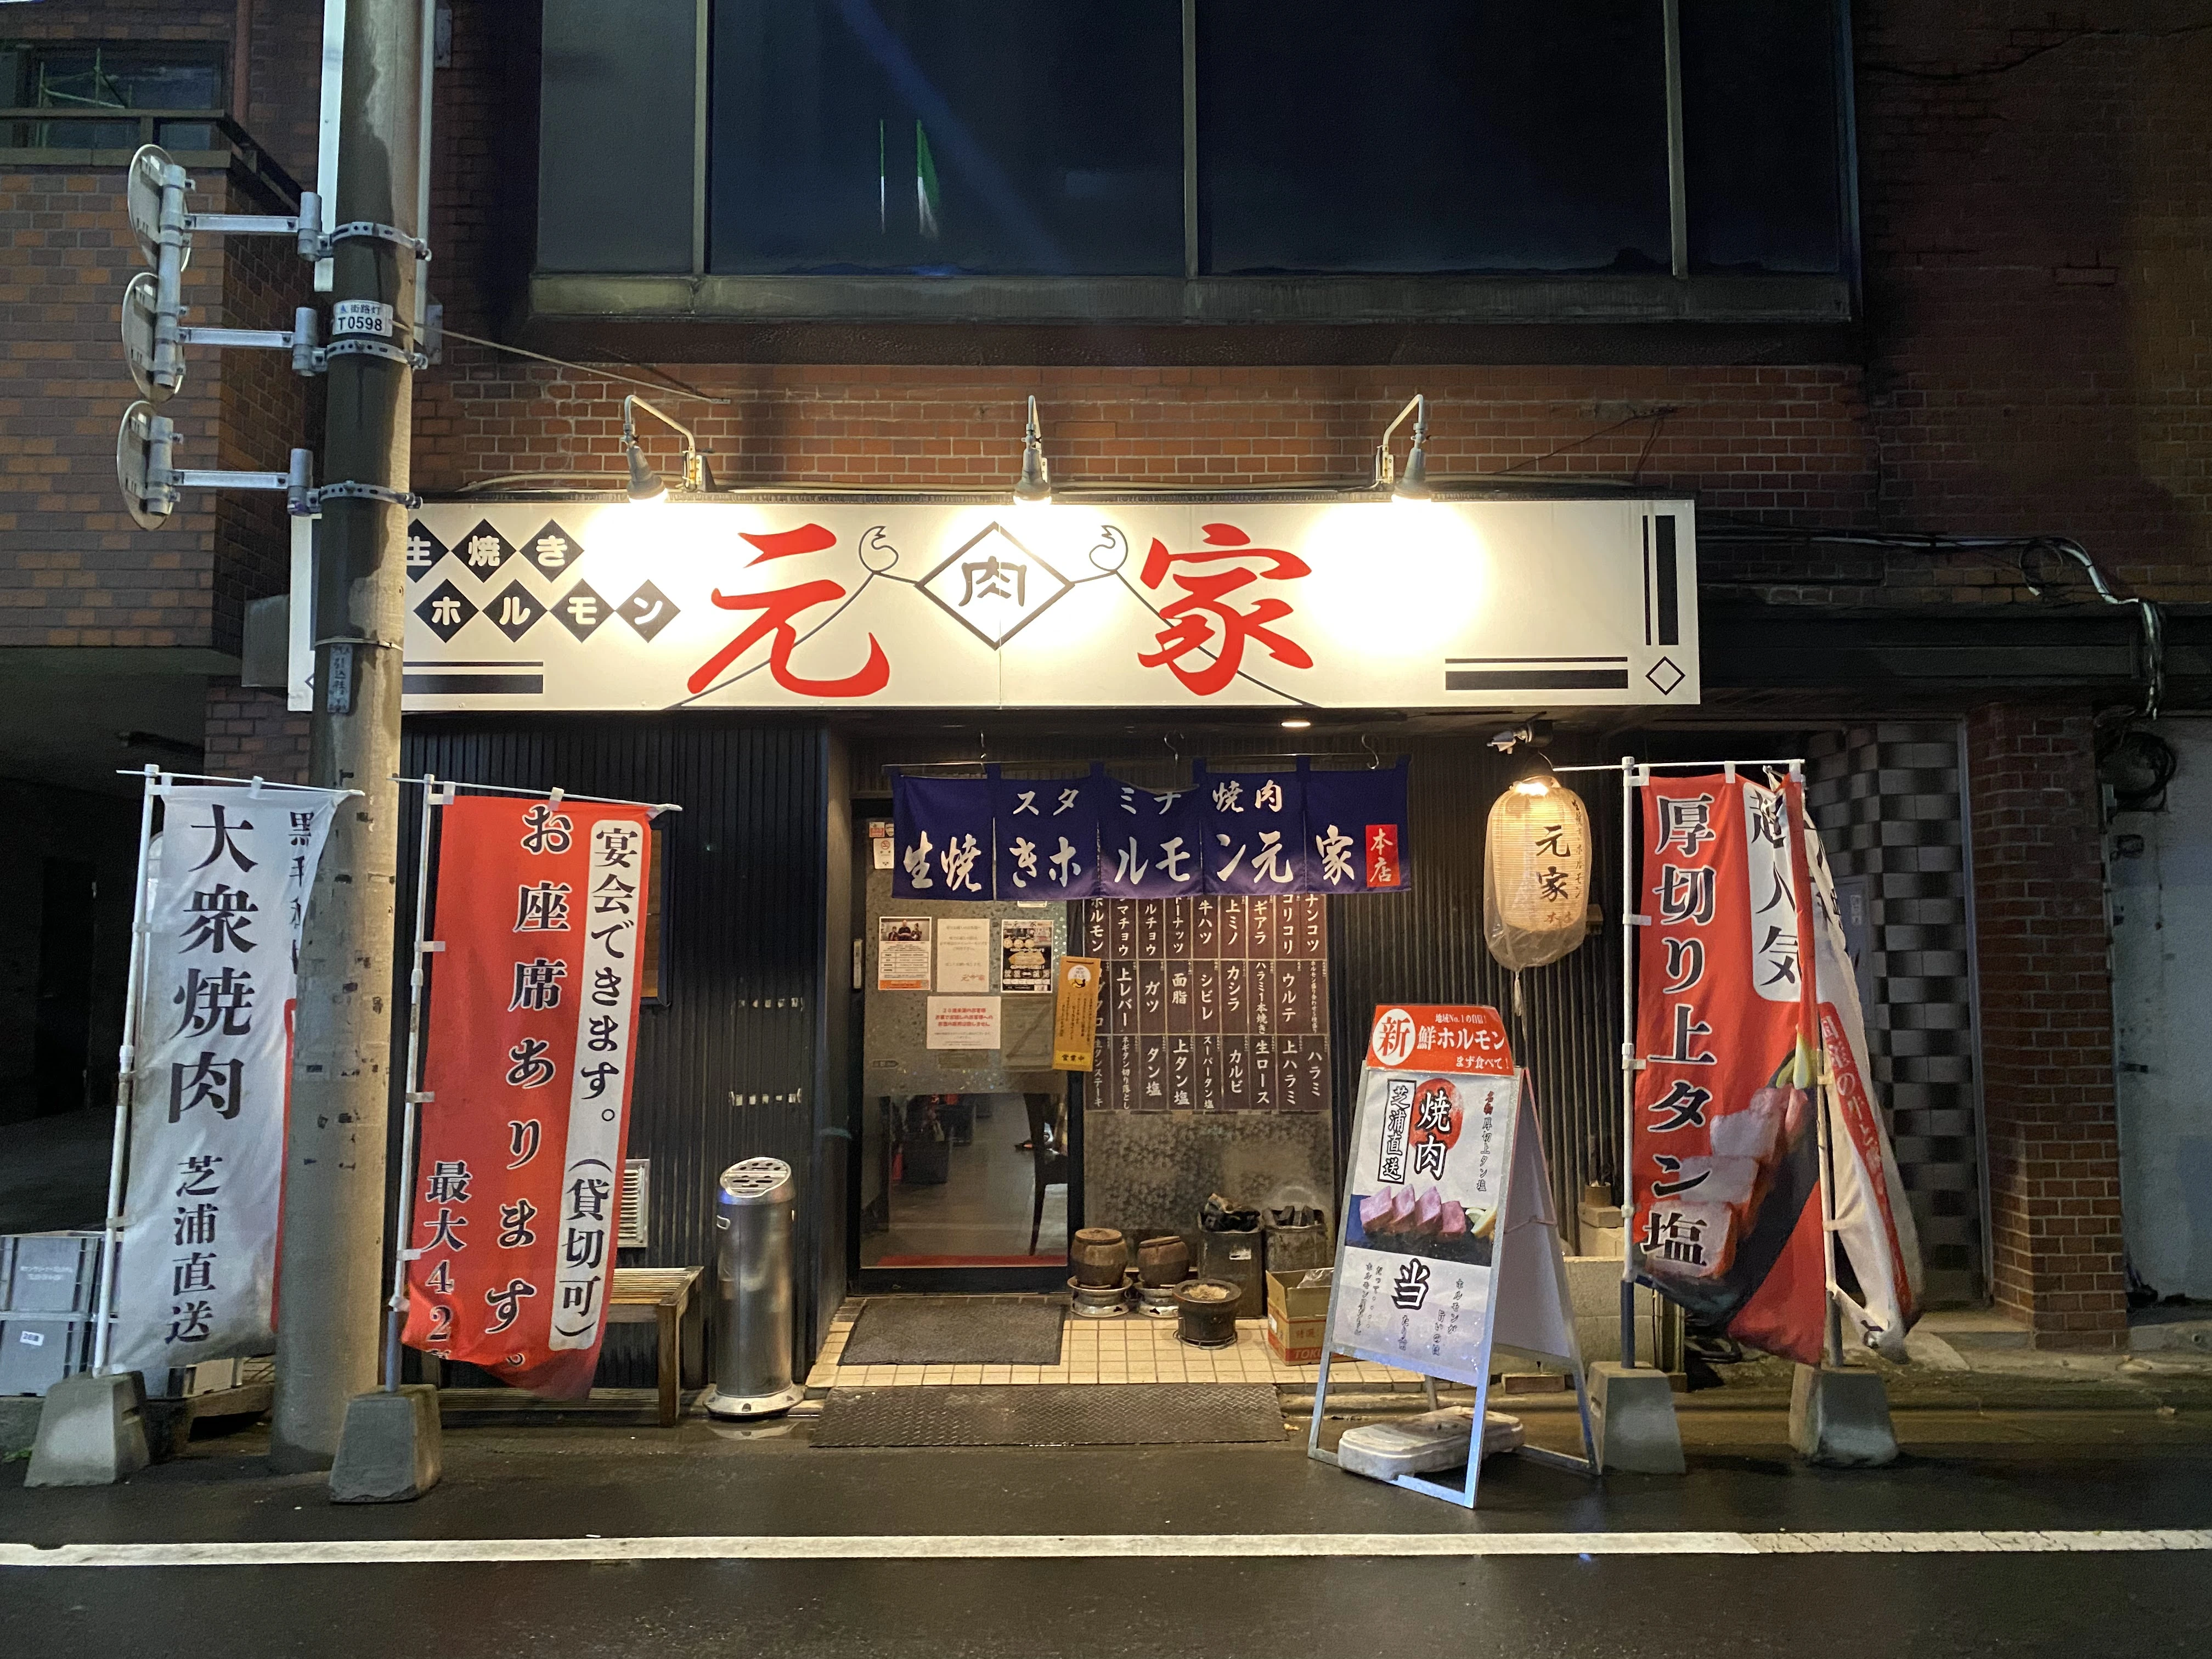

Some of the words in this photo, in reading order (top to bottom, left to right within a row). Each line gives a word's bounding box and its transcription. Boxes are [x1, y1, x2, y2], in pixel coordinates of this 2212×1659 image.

[338, 316, 382, 331] T0598
[407, 534, 568, 568] 生焼き
[431, 596, 663, 625] ホルモン
[687, 523, 890, 697] 元
[959, 555, 1025, 608] 肉
[1137, 522, 1313, 696] 家
[1012, 780, 1283, 816] スタミナ焼肉
[903, 825, 1355, 893] 生焼きホルモン元家
[1369, 827, 1393, 884] 本店
[1535, 825, 1571, 902] 元家
[1090, 898, 1104, 952] ホルモン
[1117, 899, 1130, 956] マチョウ
[1198, 900, 1213, 944] 牛ハツ
[1225, 899, 1241, 945] 上ミノ
[1254, 900, 1267, 944] ギアラ
[1283, 894, 1294, 955] コリコリ
[1305, 894, 1319, 952] ナンコツ
[168, 804, 258, 1124] 大衆焼肉
[1171, 973, 1188, 1005] 面脂
[1227, 966, 1241, 1011] カシラ
[1116, 968, 1132, 1026] 上レバー
[1144, 981, 1161, 1013] ガツ
[1201, 974, 1213, 1020] シビレ
[1282, 973, 1296, 1022] ウルテ
[1641, 792, 1717, 1267] 厚切り上タン塩
[1146, 1047, 1163, 1096] タン塩
[1172, 1039, 1190, 1105] 上タン塩
[1228, 1049, 1243, 1093] カルビ
[1255, 1040, 1270, 1104] 生ロース
[1282, 1040, 1298, 1104] 上ハラミ
[1307, 1051, 1323, 1096] ハラミ
[1383, 1084, 1410, 1181] 芝浦直送
[1414, 1089, 1453, 1181] 焼肉
[165, 1155, 222, 1344] 芝浦直送
[421, 1160, 473, 1358] 最大42
[1295, 1349, 1322, 1359] TOK
